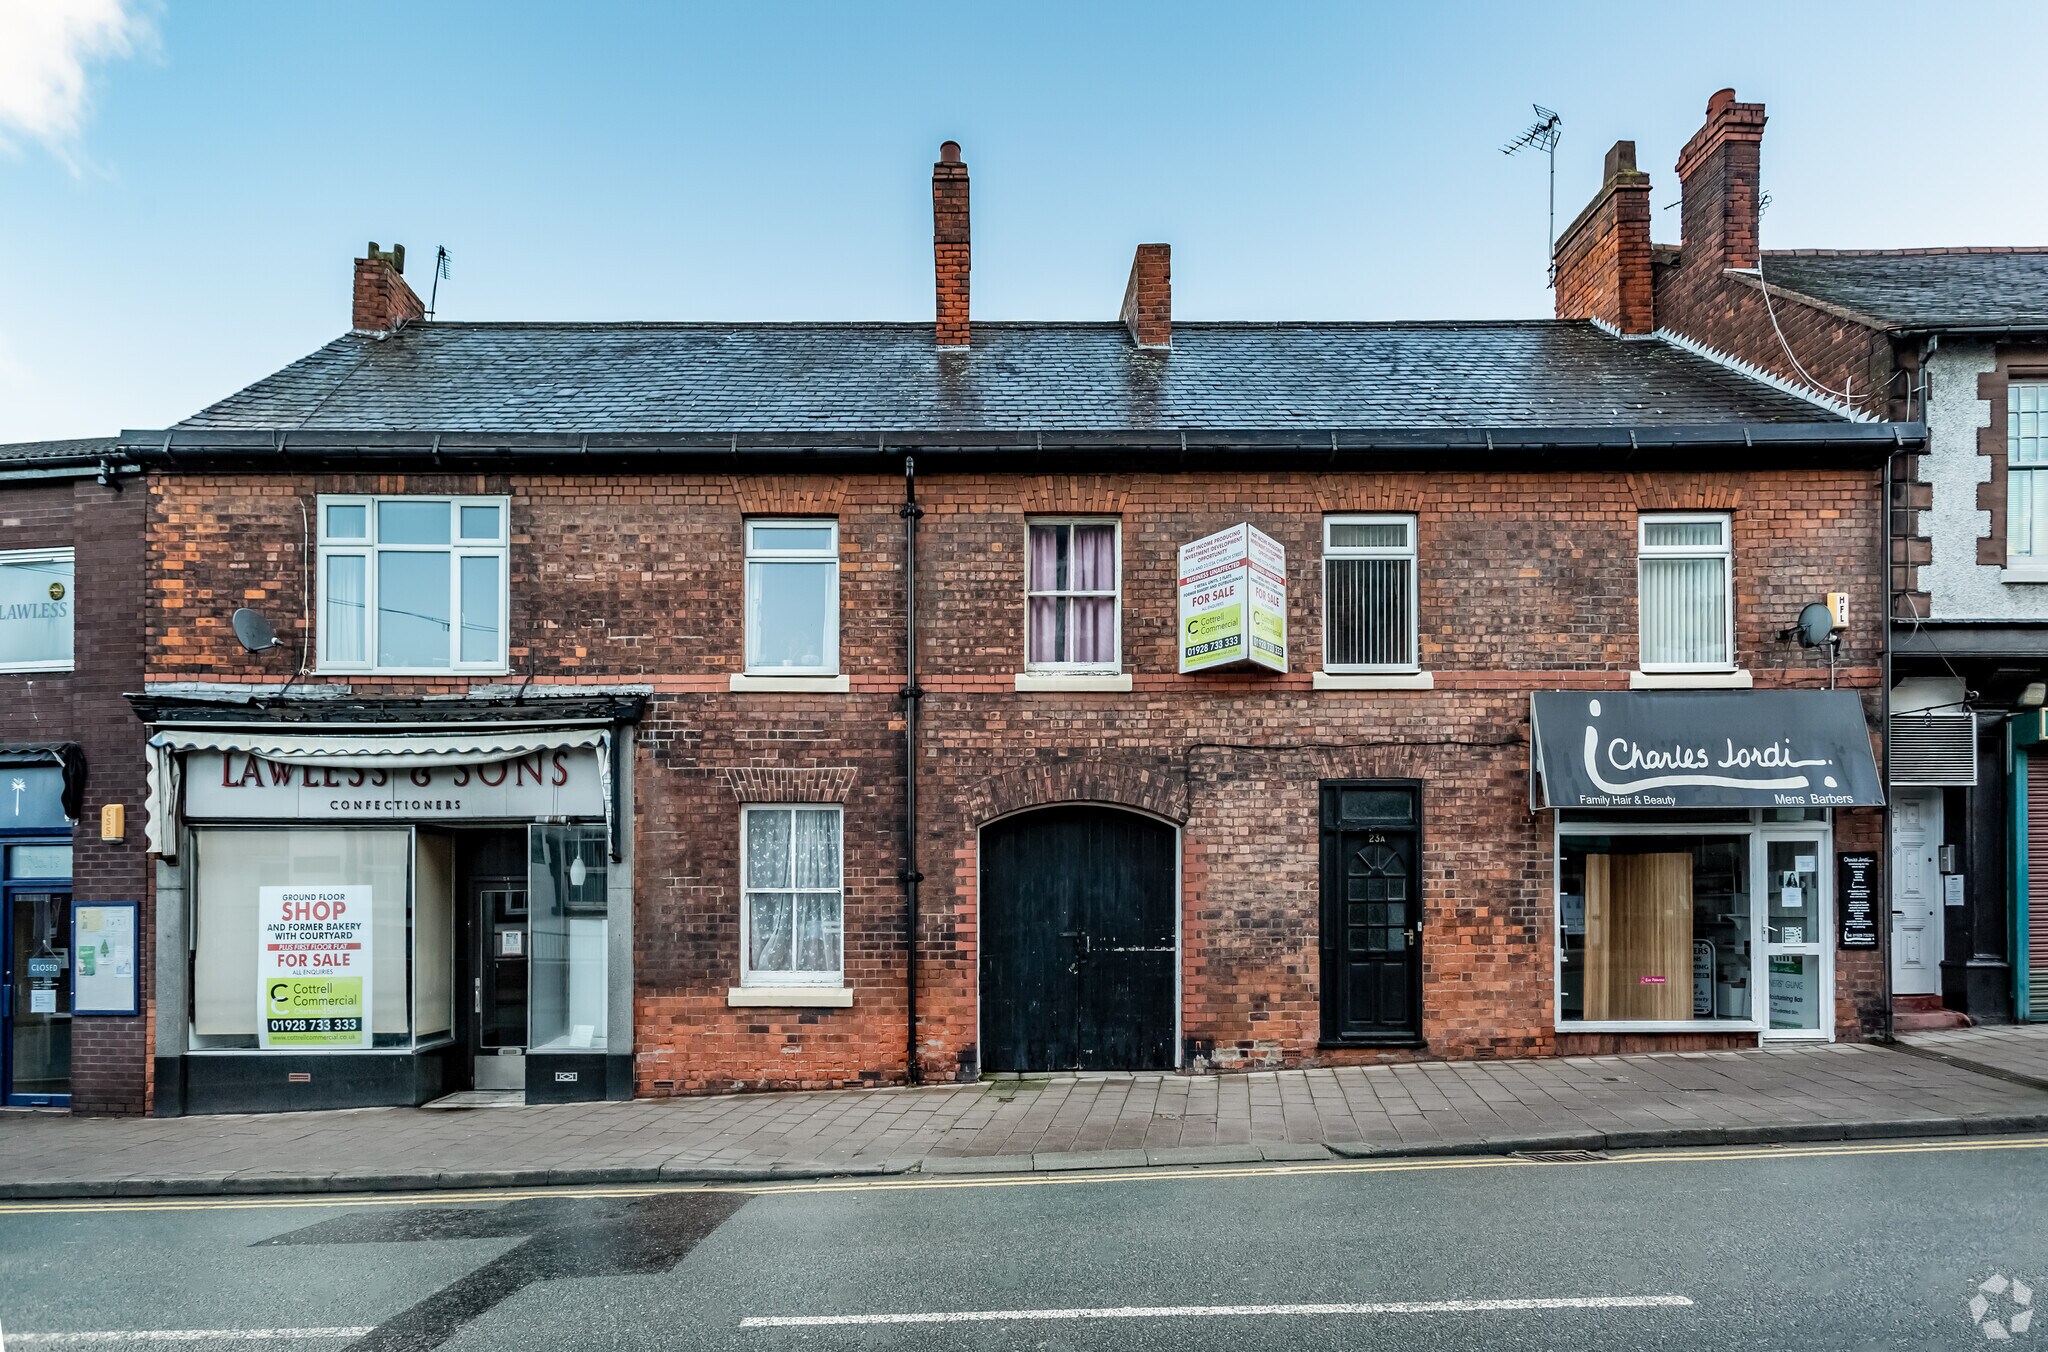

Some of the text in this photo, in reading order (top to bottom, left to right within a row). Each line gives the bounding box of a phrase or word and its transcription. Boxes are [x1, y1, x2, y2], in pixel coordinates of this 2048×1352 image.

[1196, 540, 1213, 550] INCOME
[1214, 530, 1240, 543] PRODUCING
[1184, 548, 1209, 561] INVESTMENT
[1198, 548, 1227, 562] OPPORTUNITY
[1186, 572, 1208, 583] BUSINESS
[1209, 561, 1239, 576] UNAFFECTED
[1192, 593, 1209, 607] FOR
[1212, 586, 1234, 601] SALE
[1256, 586, 1265, 601] FOR
[1267, 592, 1278, 608] SALE
[0, 602, 67, 620] LAWLESS
[1200, 613, 1224, 626] Cottrell
[1200, 618, 1237, 635] Commercial
[1187, 636, 1237, 656] 01928 733 333
[330, 800, 461, 810] CONFECTIONERS
[1579, 795, 1676, 807] Family Hair & Beauty
[1774, 793, 1854, 805] Mens Barbers
[1368, 834, 1386, 843] 23A
[319, 893, 345, 901] FLOOR
[281, 901, 346, 921] SHOP
[288, 923, 324, 931] FORMER
[326, 922, 361, 931] BAKERY
[275, 931, 353, 940] WITH COURTYARD
[277, 953, 350, 967] FOR SALE
[293, 982, 333, 994] Cottrell
[293, 994, 357, 1006] Commercial
[271, 1018, 357, 1031] 01928 733 333
[271, 1033, 356, 1041] www.cottrellcommercial.co.uk
